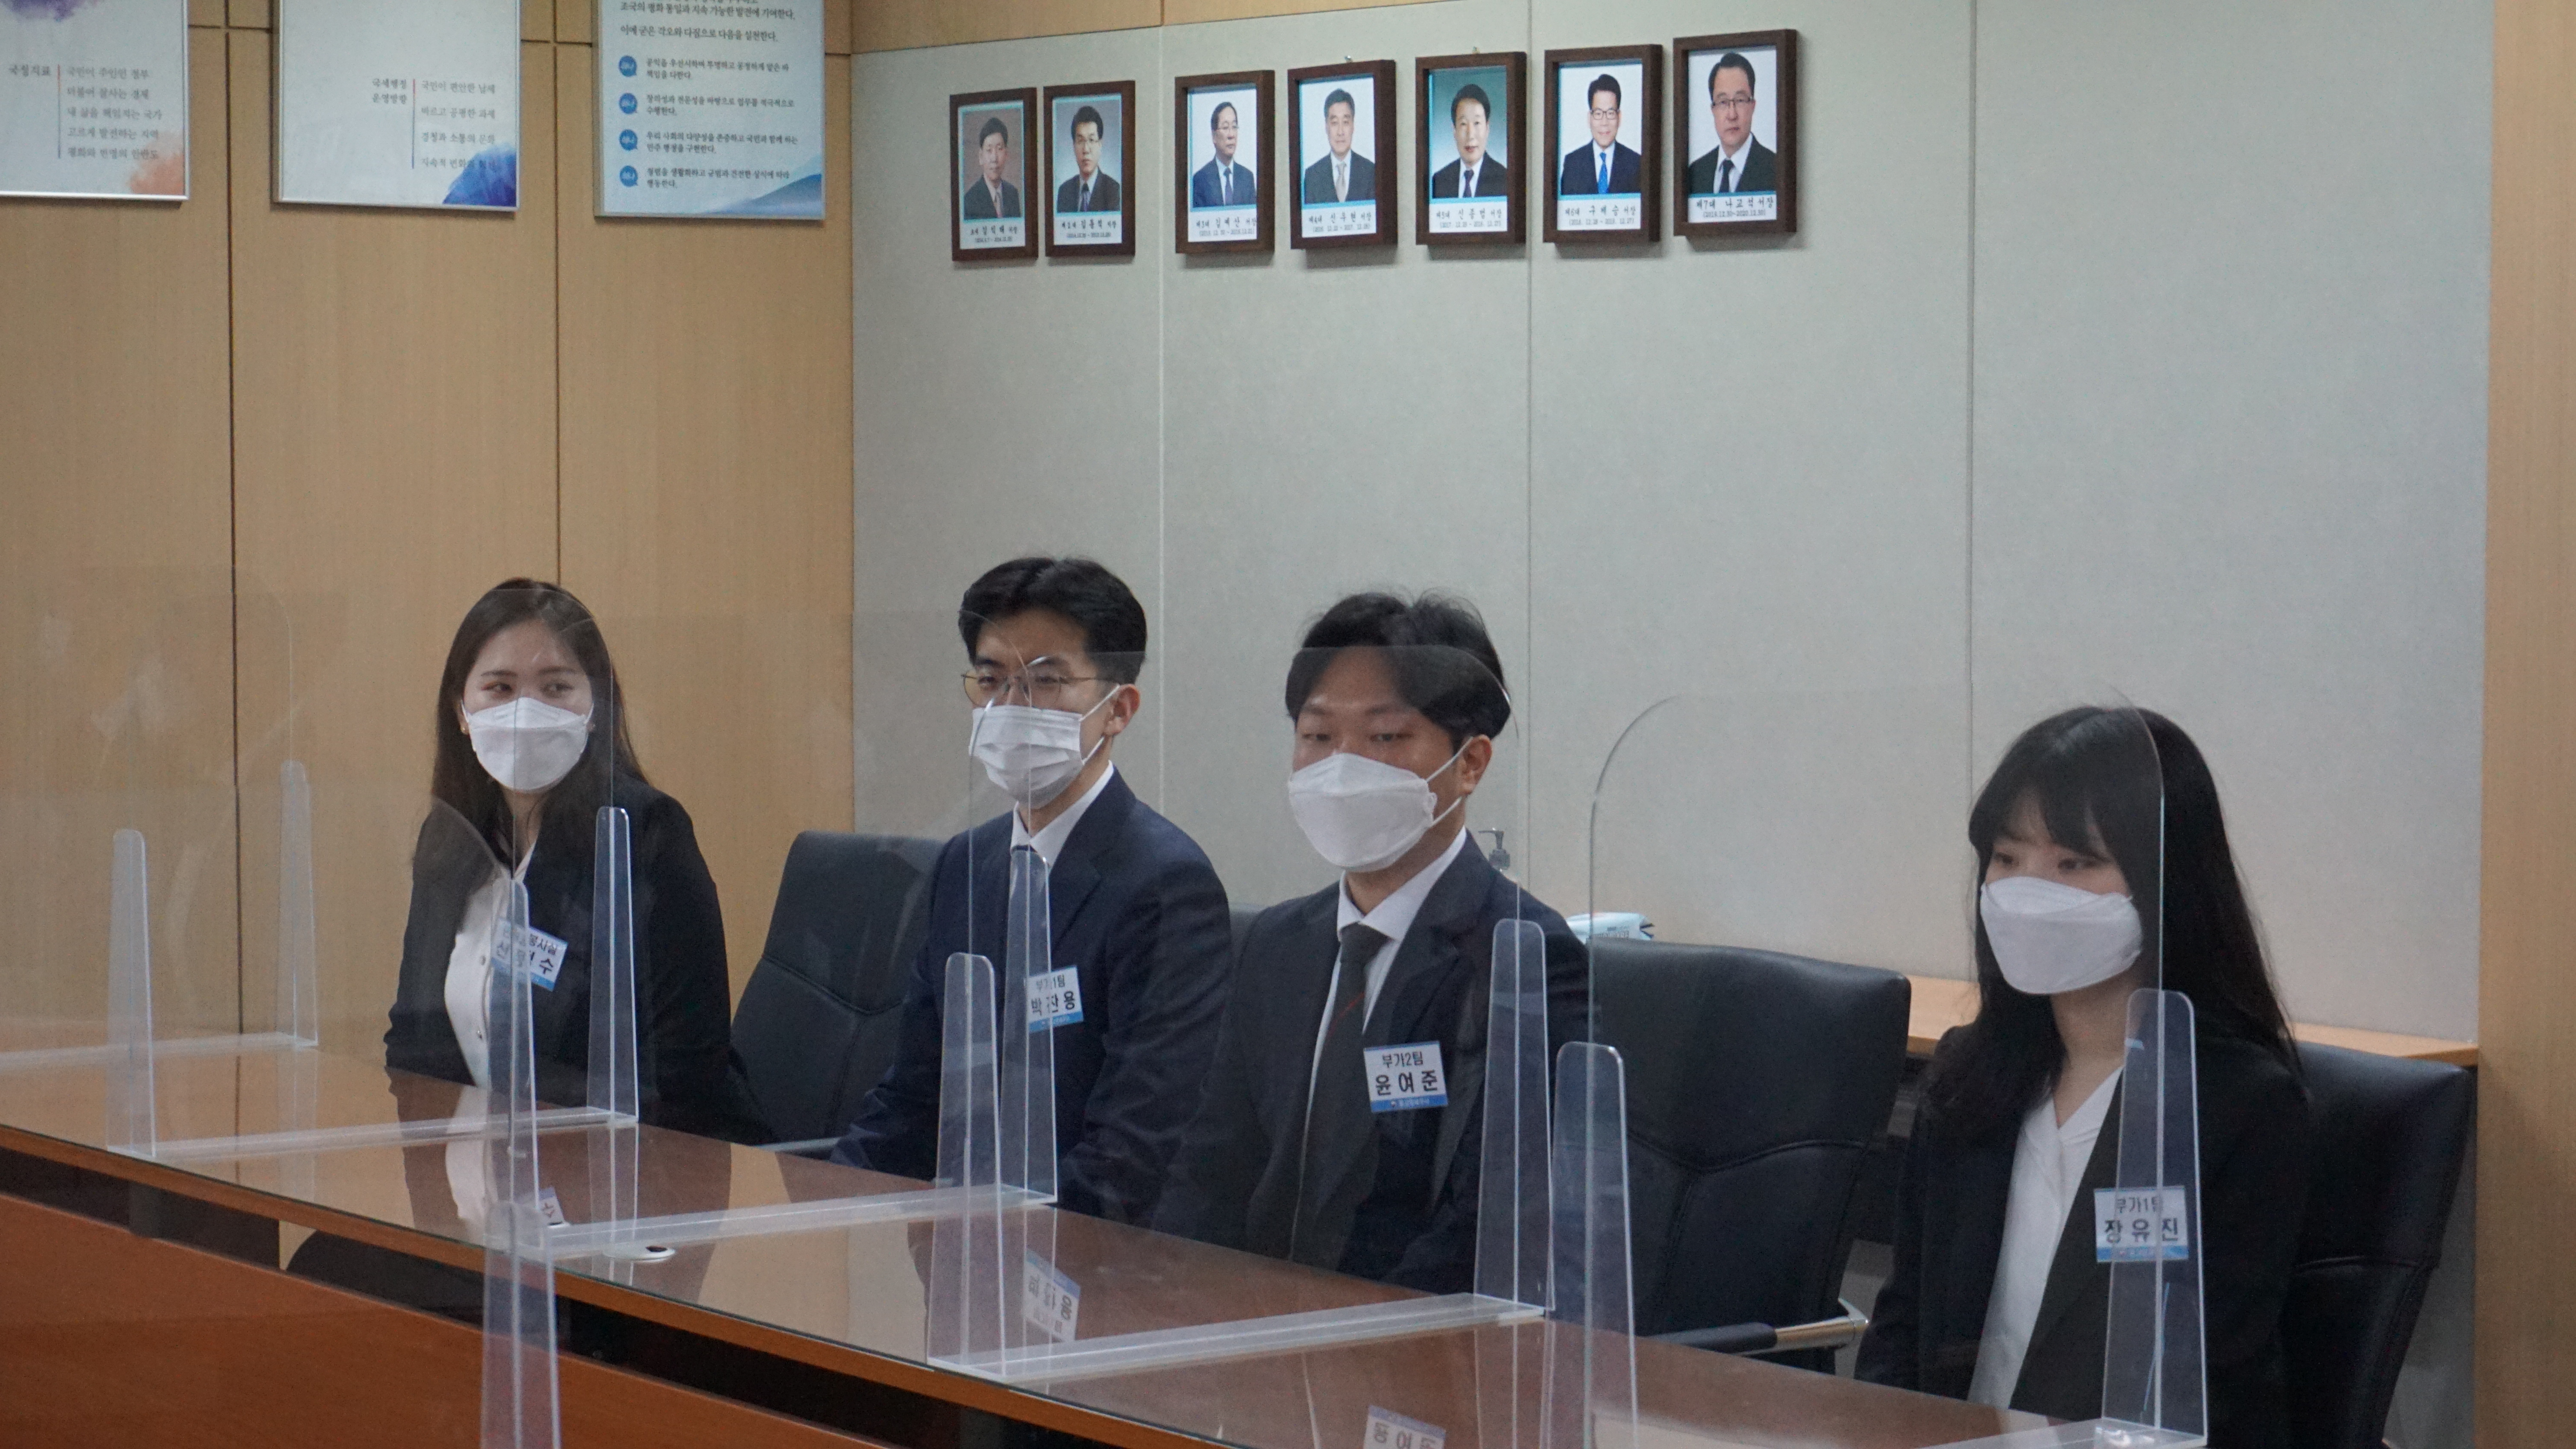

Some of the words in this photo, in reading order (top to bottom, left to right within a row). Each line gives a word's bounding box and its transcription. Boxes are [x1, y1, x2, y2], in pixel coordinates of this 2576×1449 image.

[1382, 1051, 1424, 1069] 부가2팀
[1376, 1069, 1438, 1096] 윤여준
[2104, 1217, 2178, 1243] 장유진
